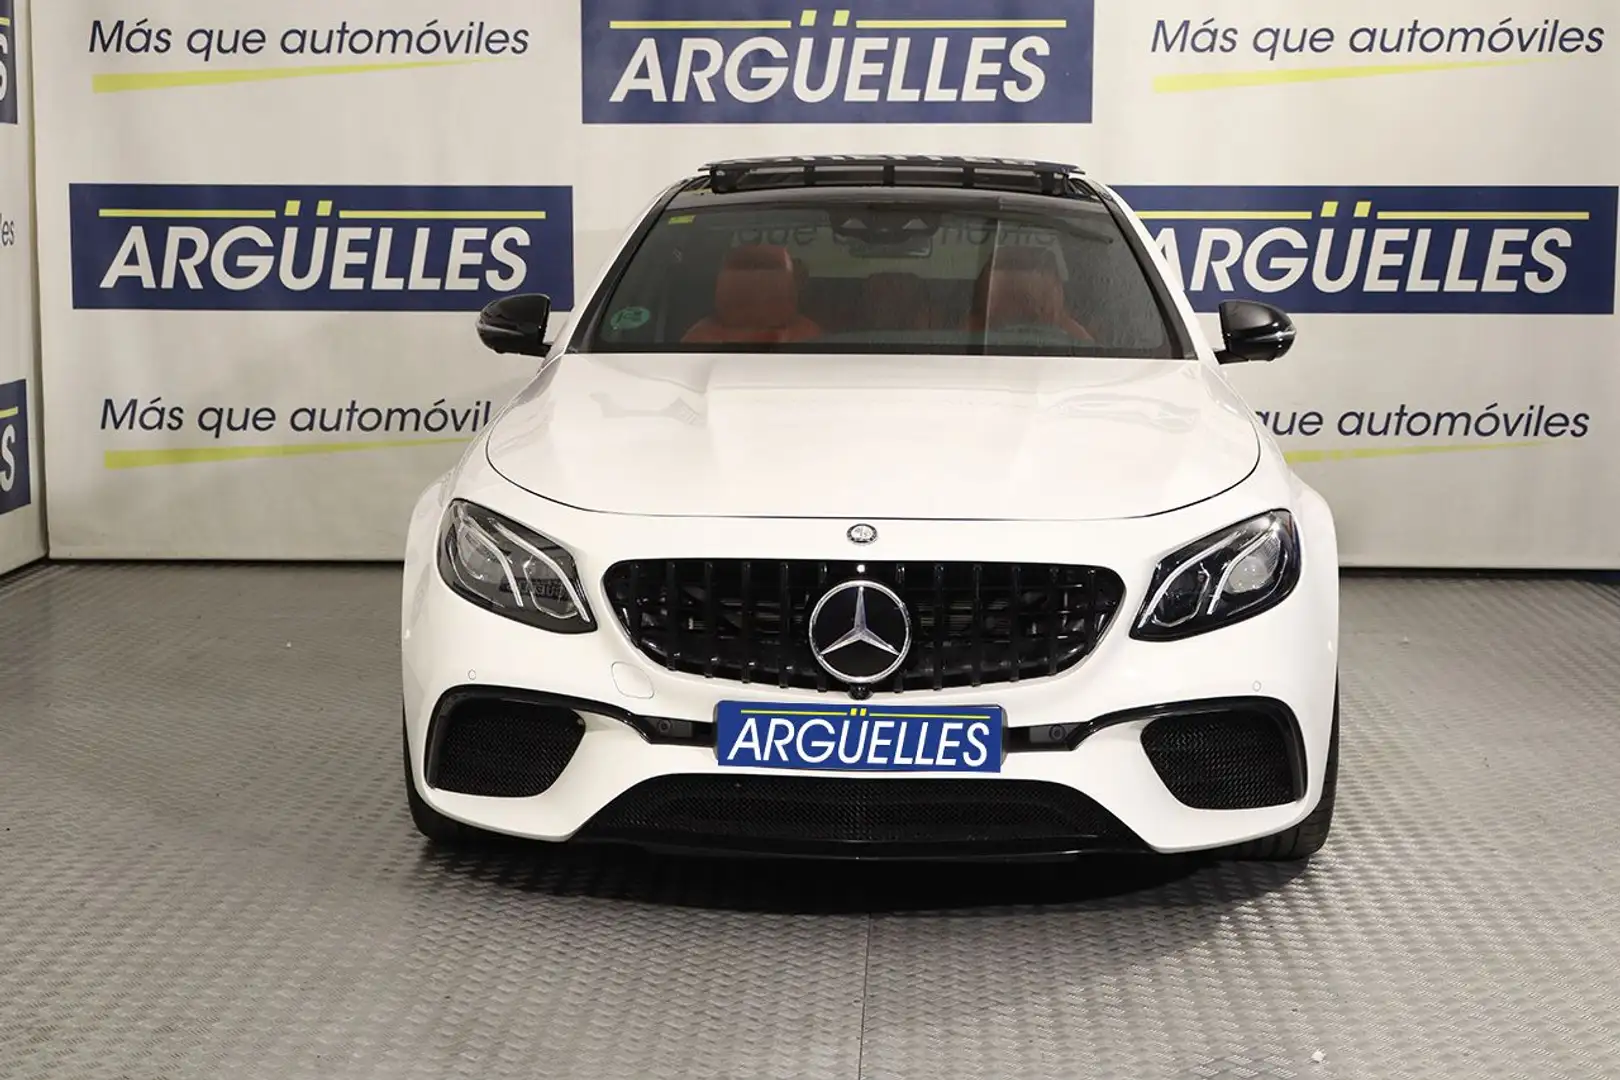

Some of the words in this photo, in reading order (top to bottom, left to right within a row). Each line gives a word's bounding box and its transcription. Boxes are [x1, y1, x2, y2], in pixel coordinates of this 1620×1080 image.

[89, 18, 172, 54] Más
[187, 28, 266, 62] que
[280, 19, 529, 54] automóviles
[609, 10, 1050, 103] ARGÜELLES
[1151, 18, 1237, 53] Más
[1253, 27, 1335, 60] que
[1349, 18, 1604, 54] automóviles
[99, 201, 531, 291] ARGÜELLES
[101, 397, 184, 431] Más
[197, 407, 277, 440] que
[290, 399, 491, 432] automóvil
[1337, 403, 1590, 438] automóviles
[727, 708, 990, 766] ARGÜELLES
